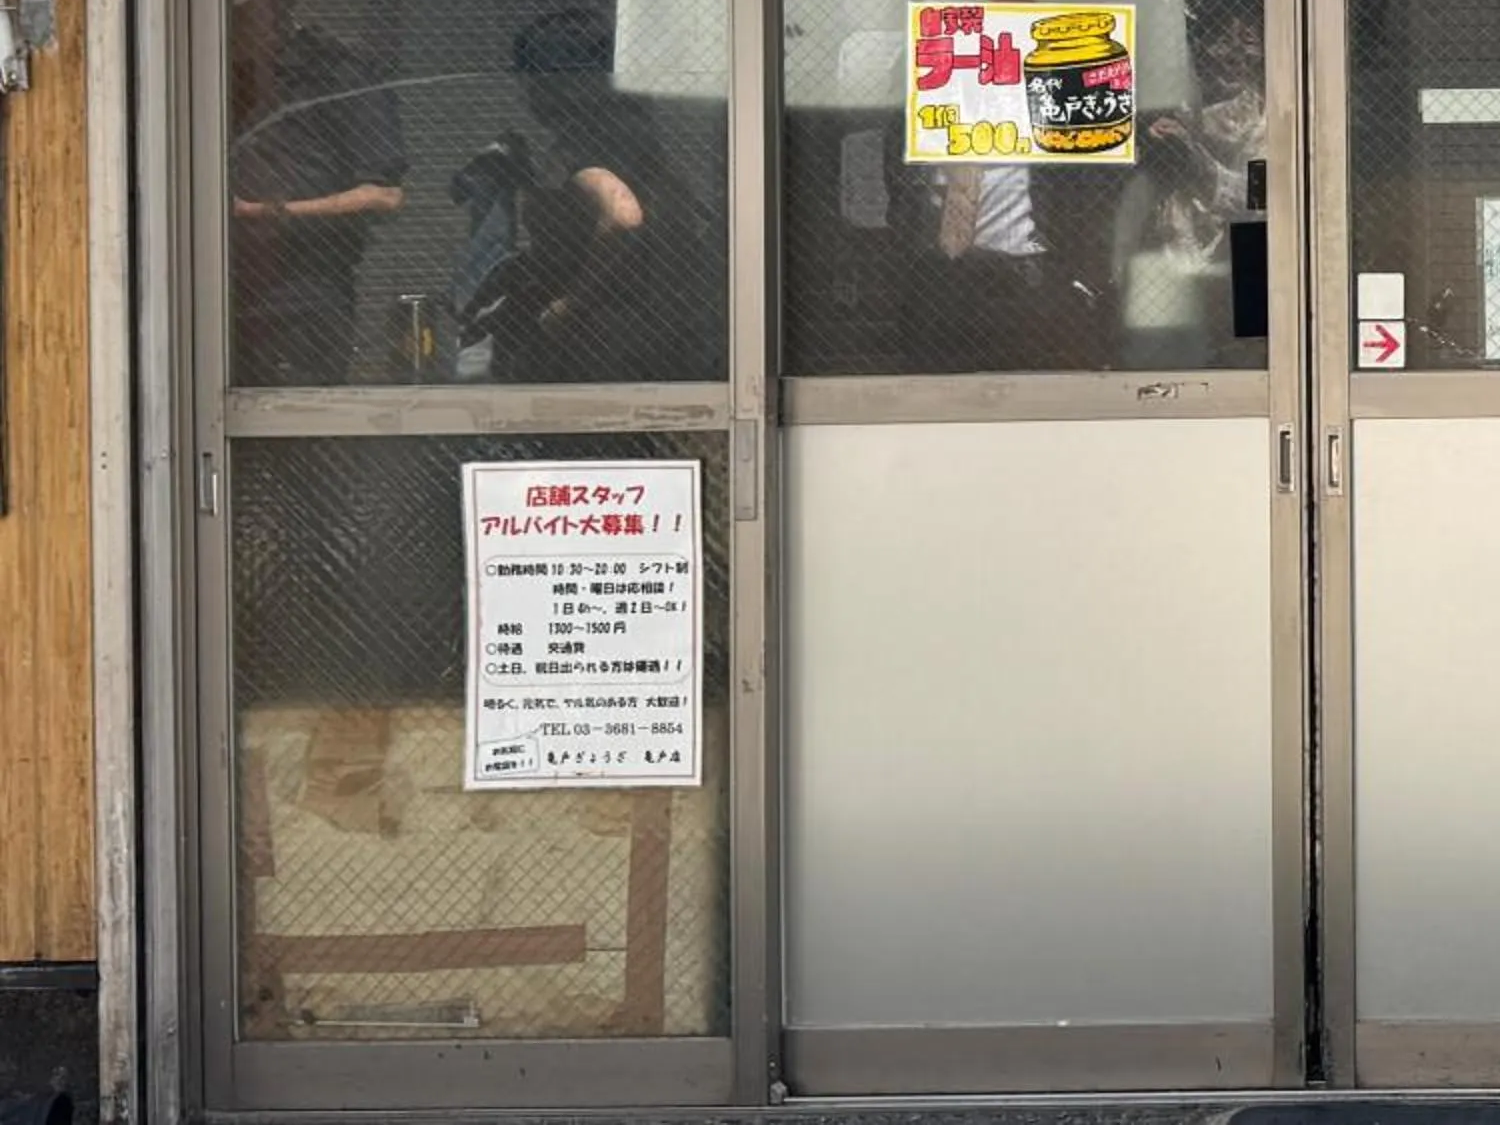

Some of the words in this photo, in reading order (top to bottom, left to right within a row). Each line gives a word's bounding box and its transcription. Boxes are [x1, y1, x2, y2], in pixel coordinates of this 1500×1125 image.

[916, 32, 1021, 91] ラー油
[918, 104, 960, 129] 1個
[947, 120, 1032, 155] 500円
[526, 485, 645, 507] 店舗スタッフ
[481, 514, 682, 536] アルバイト大募集！！
[498, 623, 522, 635] 時給
[541, 723, 570, 736] TEL
